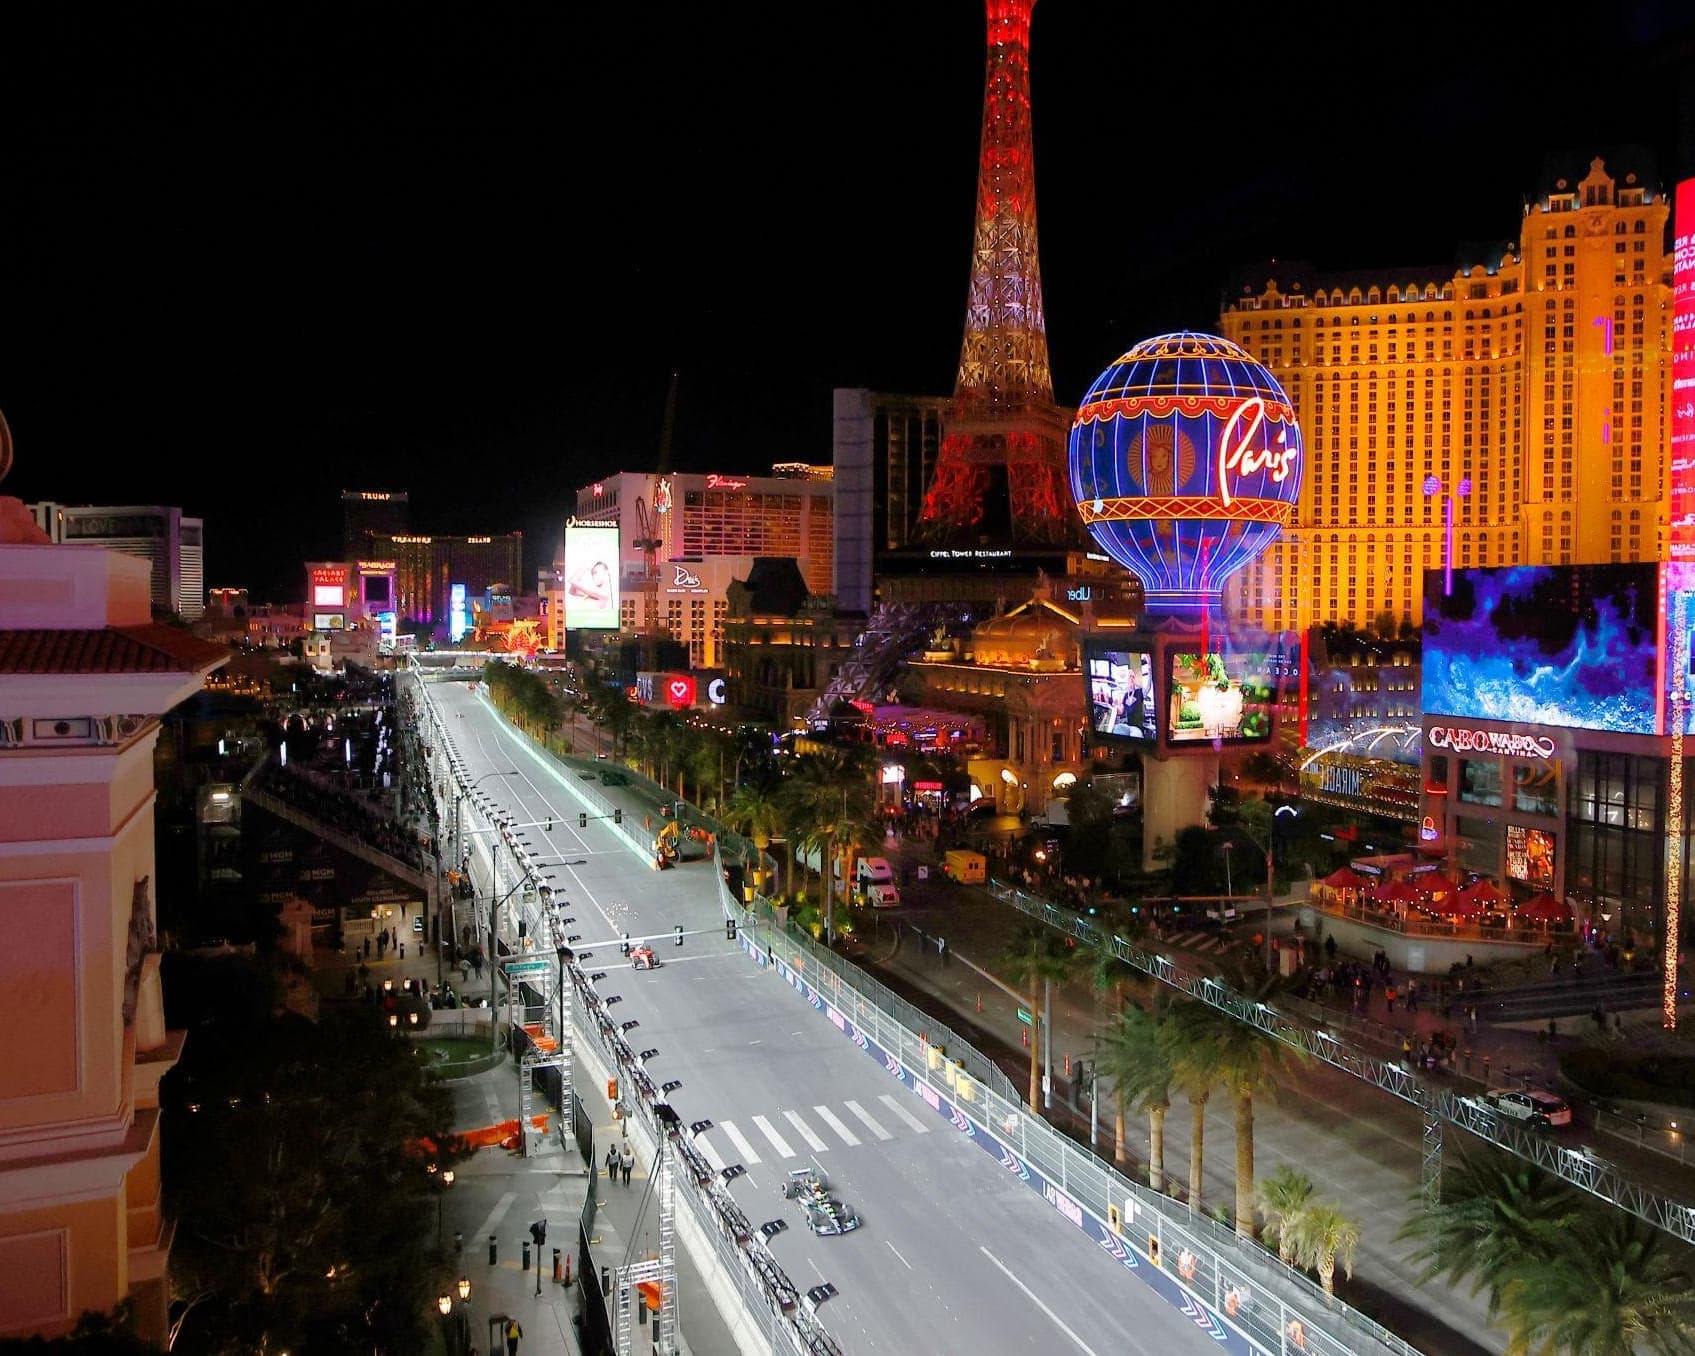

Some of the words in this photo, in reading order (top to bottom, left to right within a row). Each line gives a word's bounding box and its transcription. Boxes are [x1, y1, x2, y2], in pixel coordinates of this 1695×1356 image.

[1218, 397, 1298, 507] Paris
[361, 492, 391, 501] TRUMP
[391, 536, 432, 544] TREASURE
[951, 550, 973, 558] TOWER
[1429, 727, 1489, 752] CABO
[1488, 731, 1545, 756] WABO
[1492, 748, 1533, 758] CANTINA
